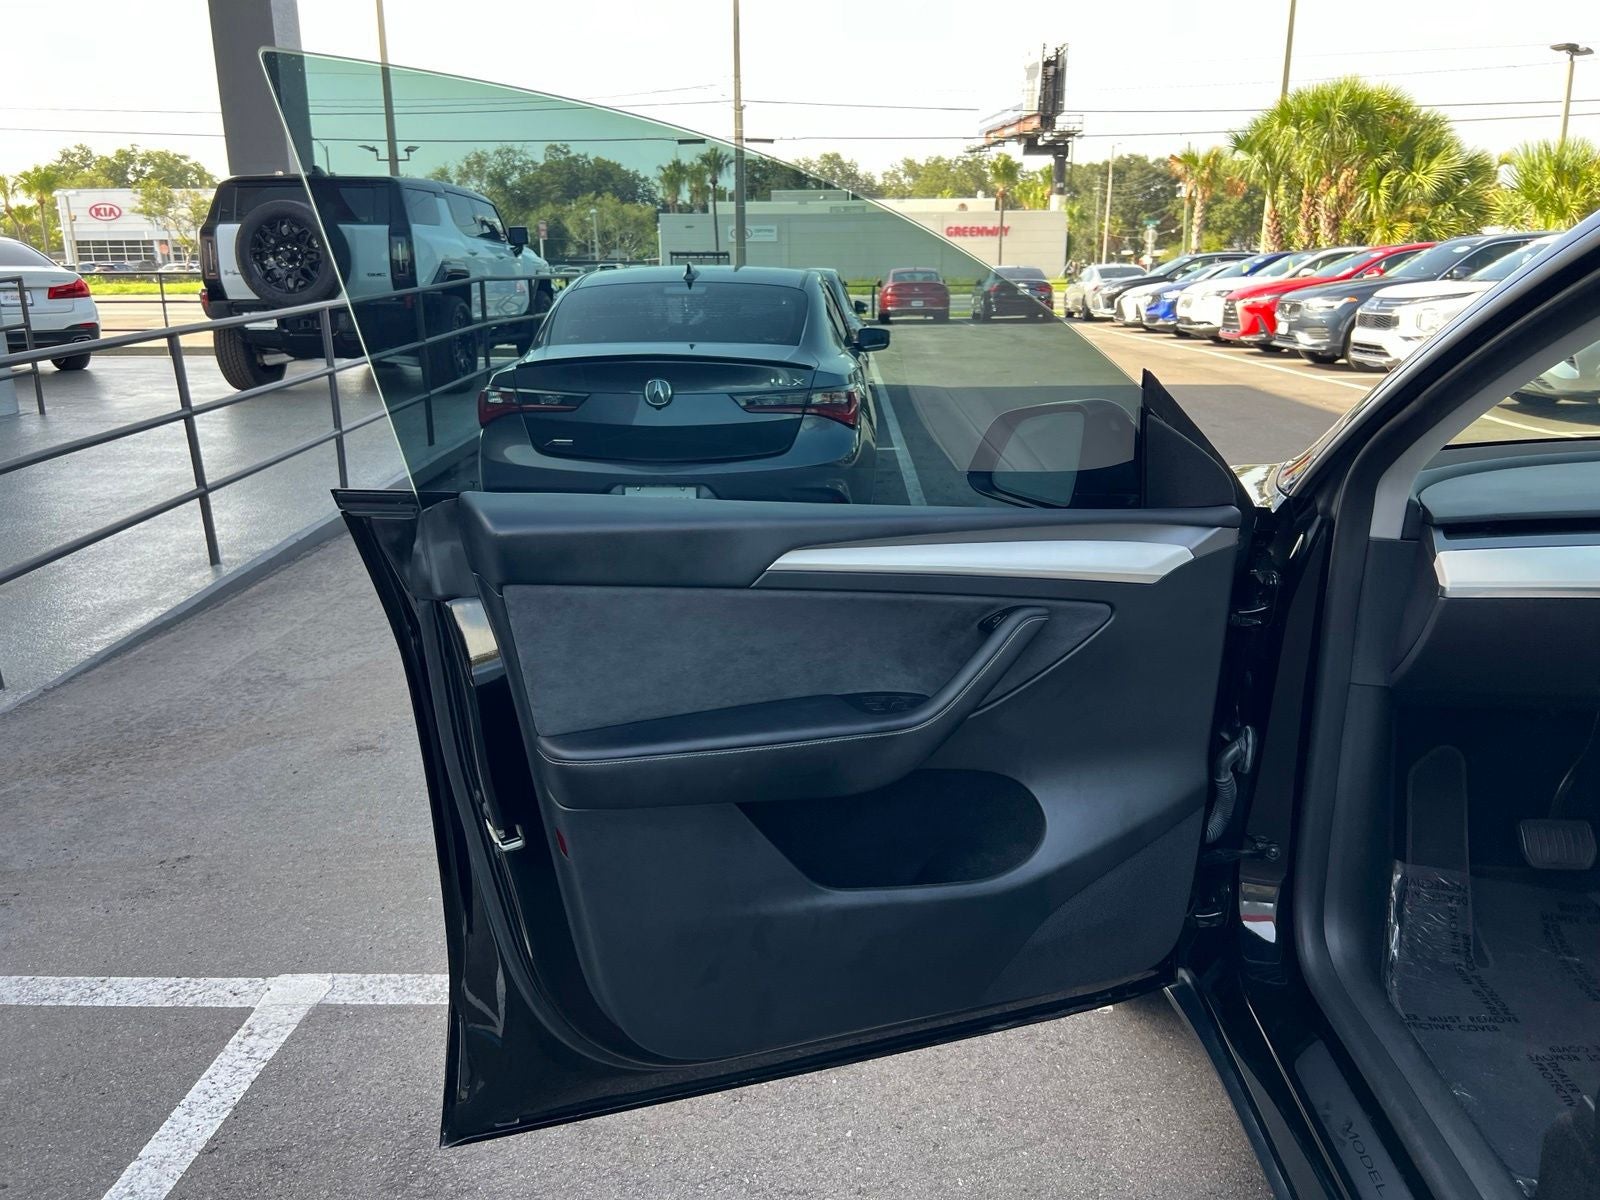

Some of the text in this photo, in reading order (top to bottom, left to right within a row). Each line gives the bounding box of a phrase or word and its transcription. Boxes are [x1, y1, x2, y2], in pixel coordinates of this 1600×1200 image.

[945, 225, 1010, 237] GREENWAY
[1427, 1015, 1462, 1023] MUST
[1468, 1015, 1521, 1024] REMOVE
[1458, 1024, 1501, 1033] COVER
[1532, 1062, 1577, 1108] PROTECTIV
[1342, 1120, 1386, 1198] MODEL
